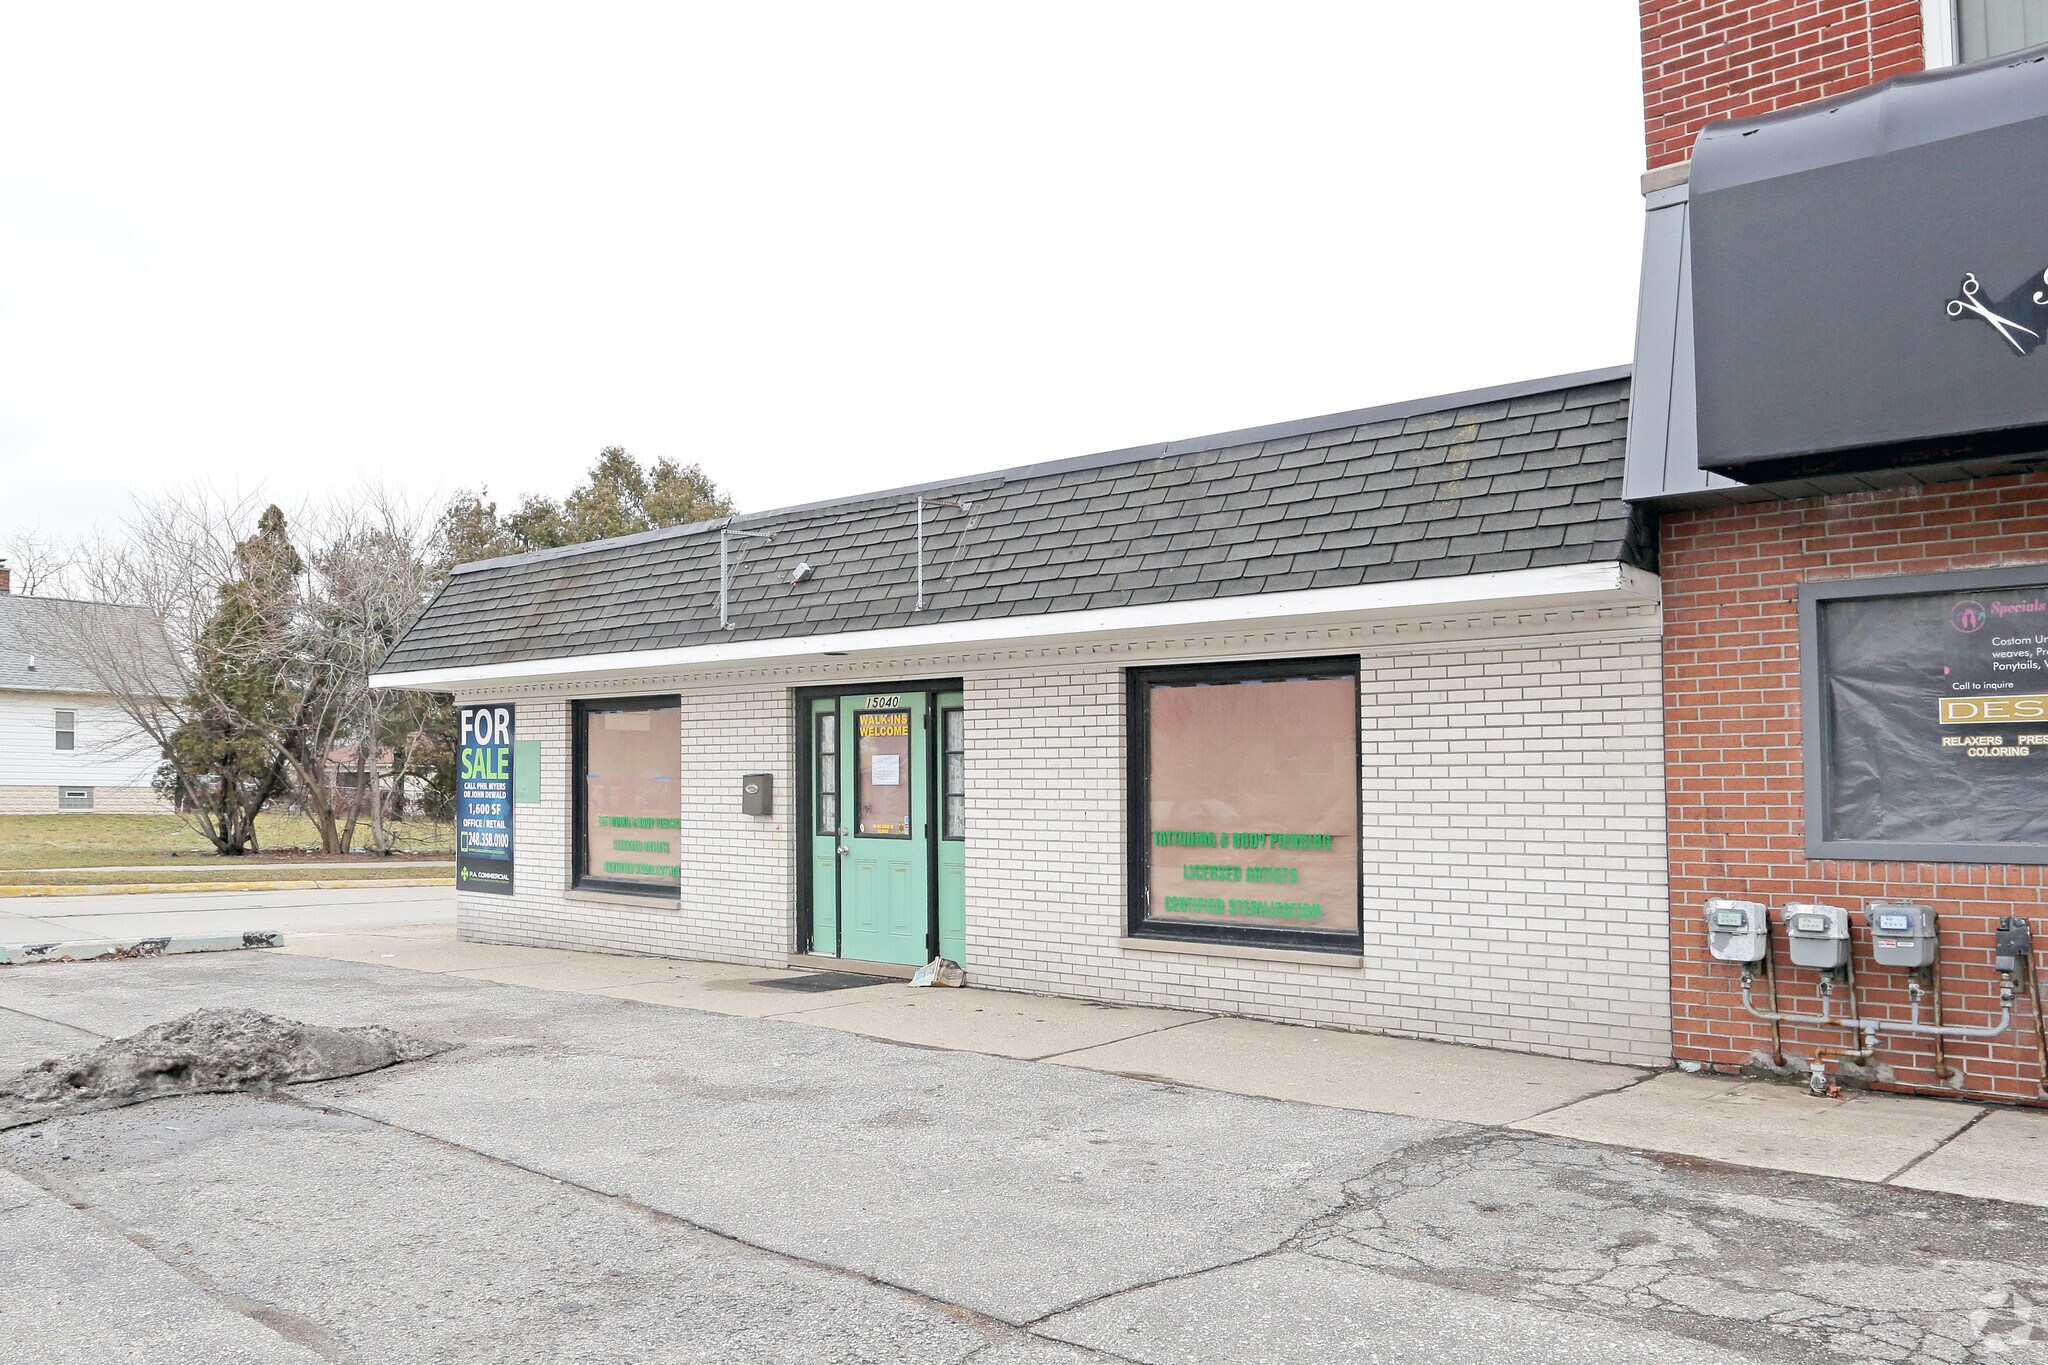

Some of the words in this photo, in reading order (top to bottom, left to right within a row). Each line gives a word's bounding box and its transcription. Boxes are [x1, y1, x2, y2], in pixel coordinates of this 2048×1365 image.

[1991, 599, 2047, 618] Specials
[1992, 649, 2033, 659] weaves,
[2036, 647, 2048, 657] Pr
[1993, 660, 2041, 672] Ponytails,
[1952, 682, 1970, 690] Call
[1972, 682, 1982, 690] to
[1983, 680, 2014, 690] inquire
[867, 696, 899, 708] 15040
[461, 708, 510, 746] FOR
[859, 726, 908, 737] WELCOME
[1941, 735, 2003, 747] RELAXERS
[1967, 746, 2029, 757] COLORING
[461, 747, 509, 780] SALE
[464, 782, 476, 790] CALL
[471, 790, 484, 798] JOHN
[468, 803, 490, 816] 1,600
[491, 803, 502, 815] SF
[462, 818, 482, 828] OFFICE
[486, 819, 506, 829] RETAIL
[1153, 830, 1217, 848] TATTOOING
[1232, 832, 1267, 849] BODY
[1269, 832, 1332, 851] PIERCING
[1183, 864, 1241, 882] LICENSED
[1245, 866, 1299, 884] ARTISTS
[1164, 896, 1225, 915] CERTIFIED
[1228, 898, 1322, 920] STERILIZATION
